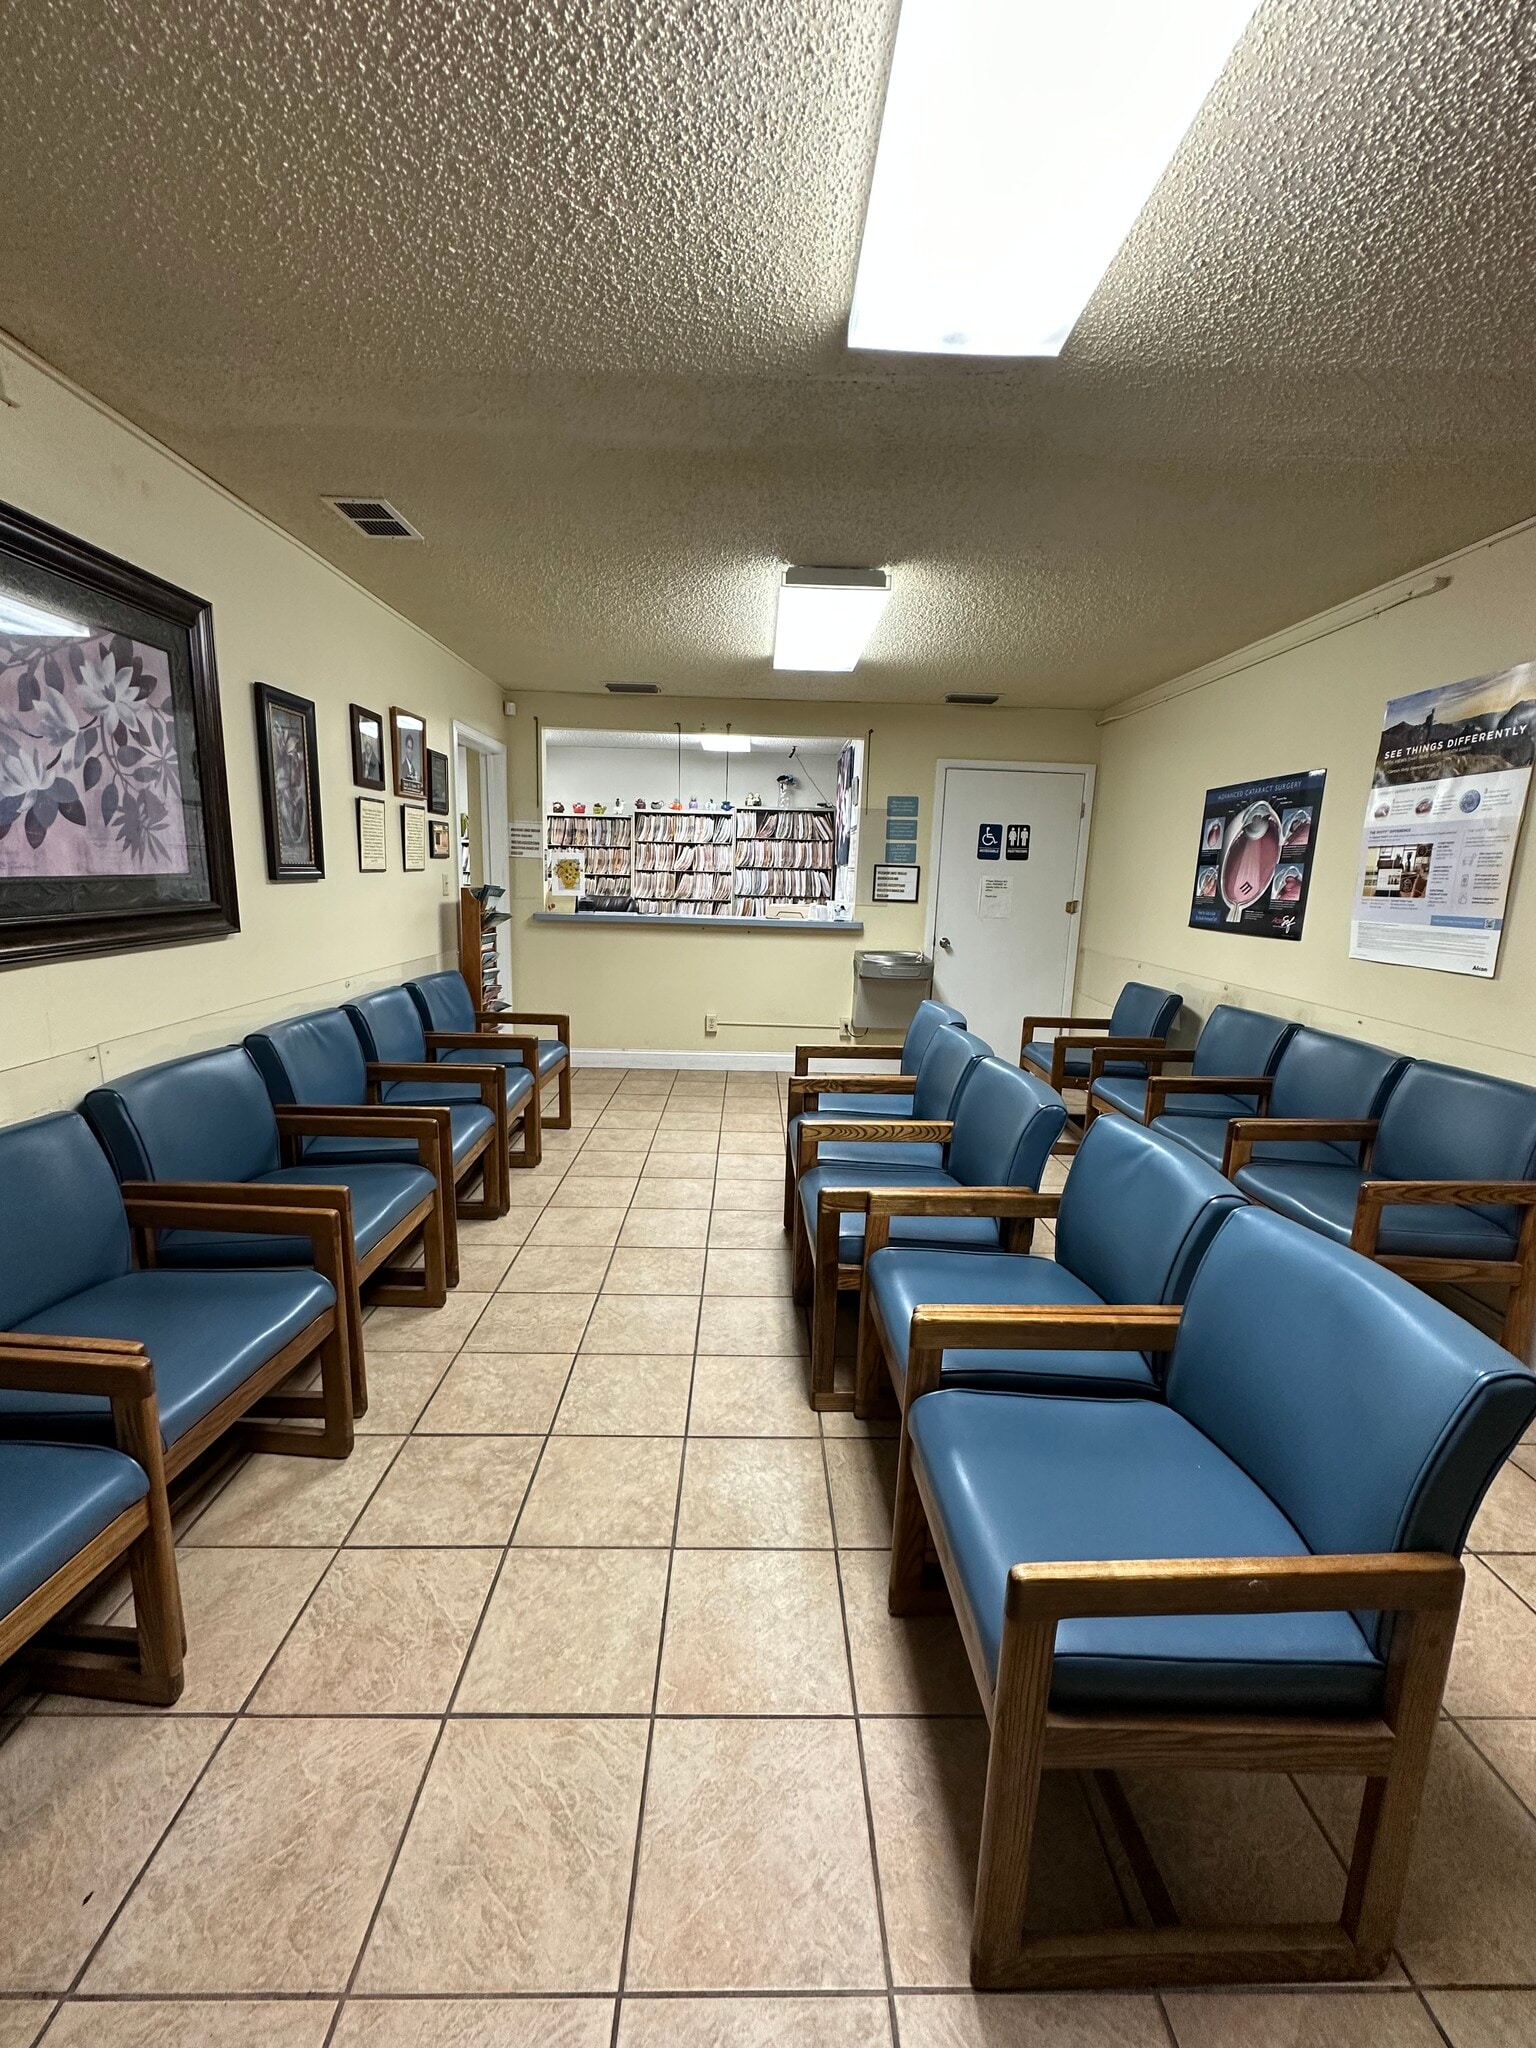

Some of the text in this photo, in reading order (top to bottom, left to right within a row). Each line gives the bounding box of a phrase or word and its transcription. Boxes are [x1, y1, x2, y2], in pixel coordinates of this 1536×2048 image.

[1384, 725, 1528, 760] SEE THINGS DIFFERENTLY
[1218, 780, 1303, 800] ADVANCED CATARACT SURGERY
